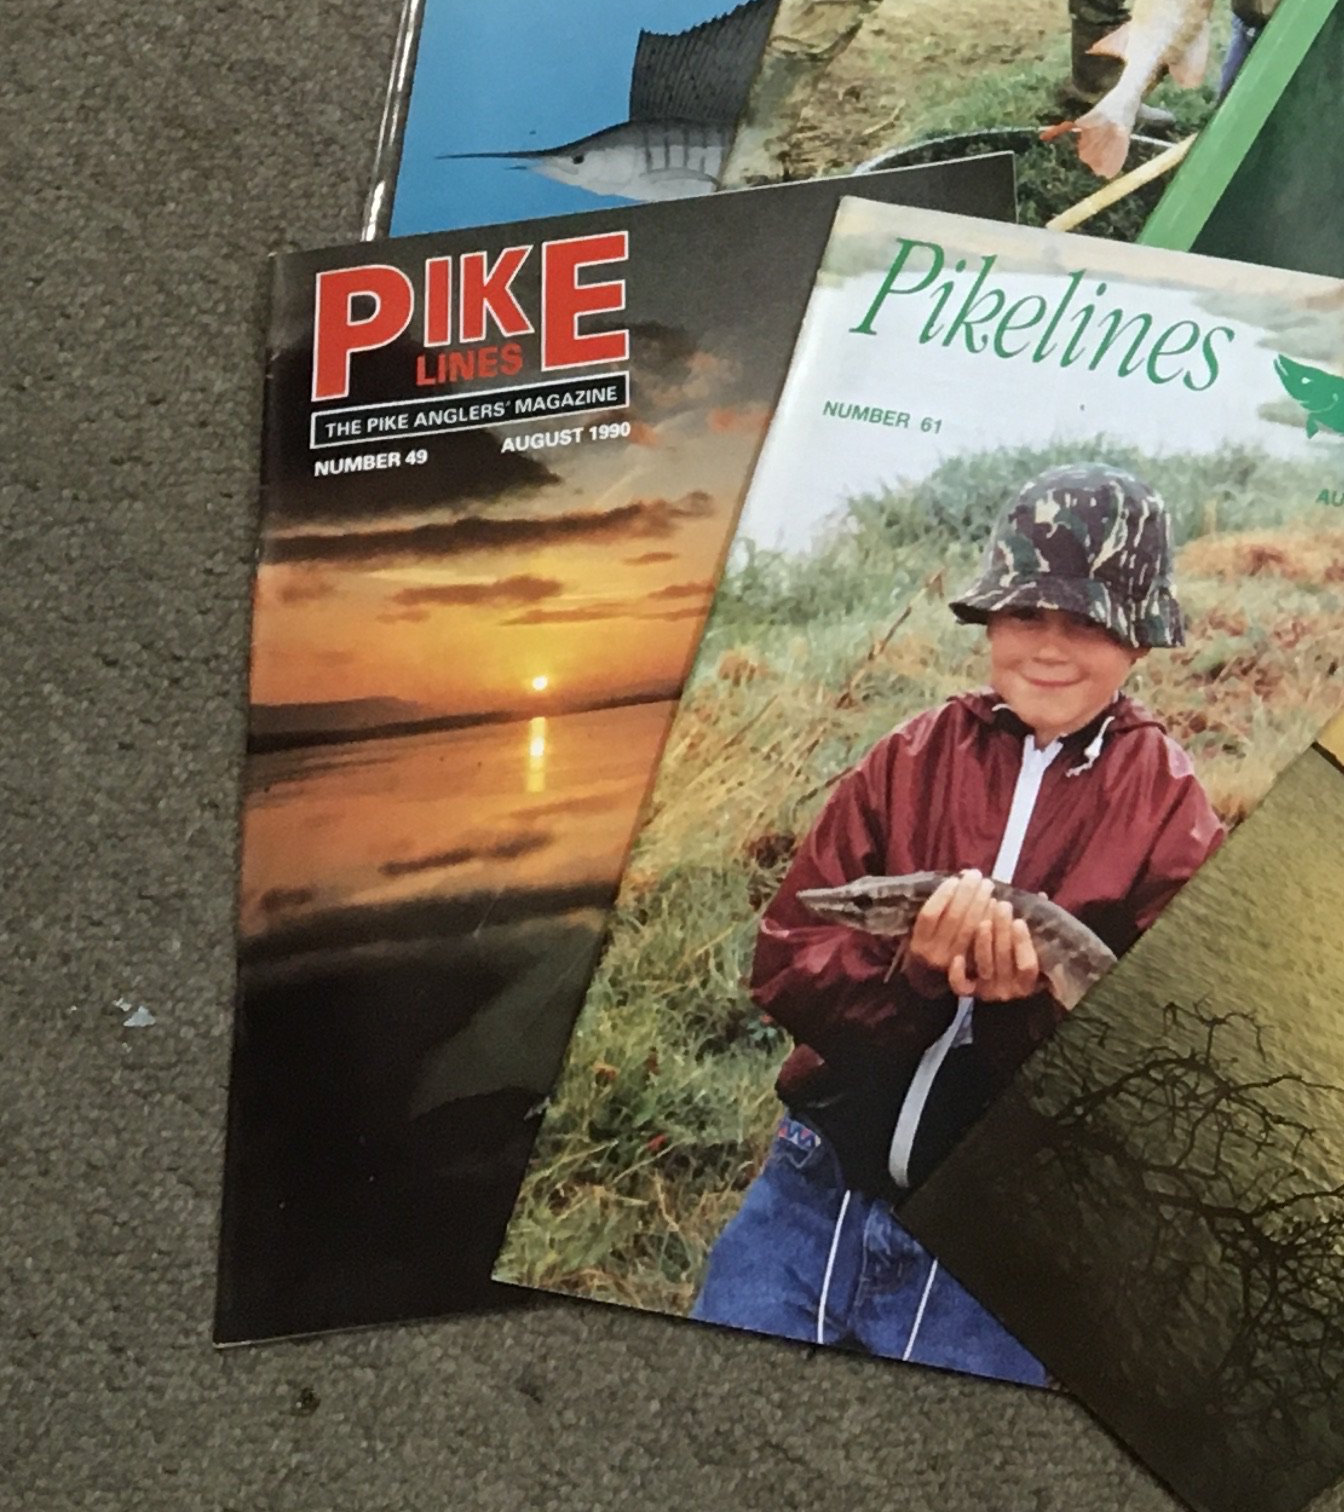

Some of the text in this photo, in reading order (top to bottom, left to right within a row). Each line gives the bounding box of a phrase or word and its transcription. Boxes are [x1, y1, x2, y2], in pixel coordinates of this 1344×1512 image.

[311, 230, 630, 403] PIKE
[848, 236, 1236, 392] Pikelines
[415, 343, 524, 386] LINES
[325, 385, 618, 439] THE PIKE ANGLERS' MAGAZINE
[822, 399, 944, 436] NUMBER 61
[314, 421, 631, 477] NUMBER 49 AUGUST 1990
